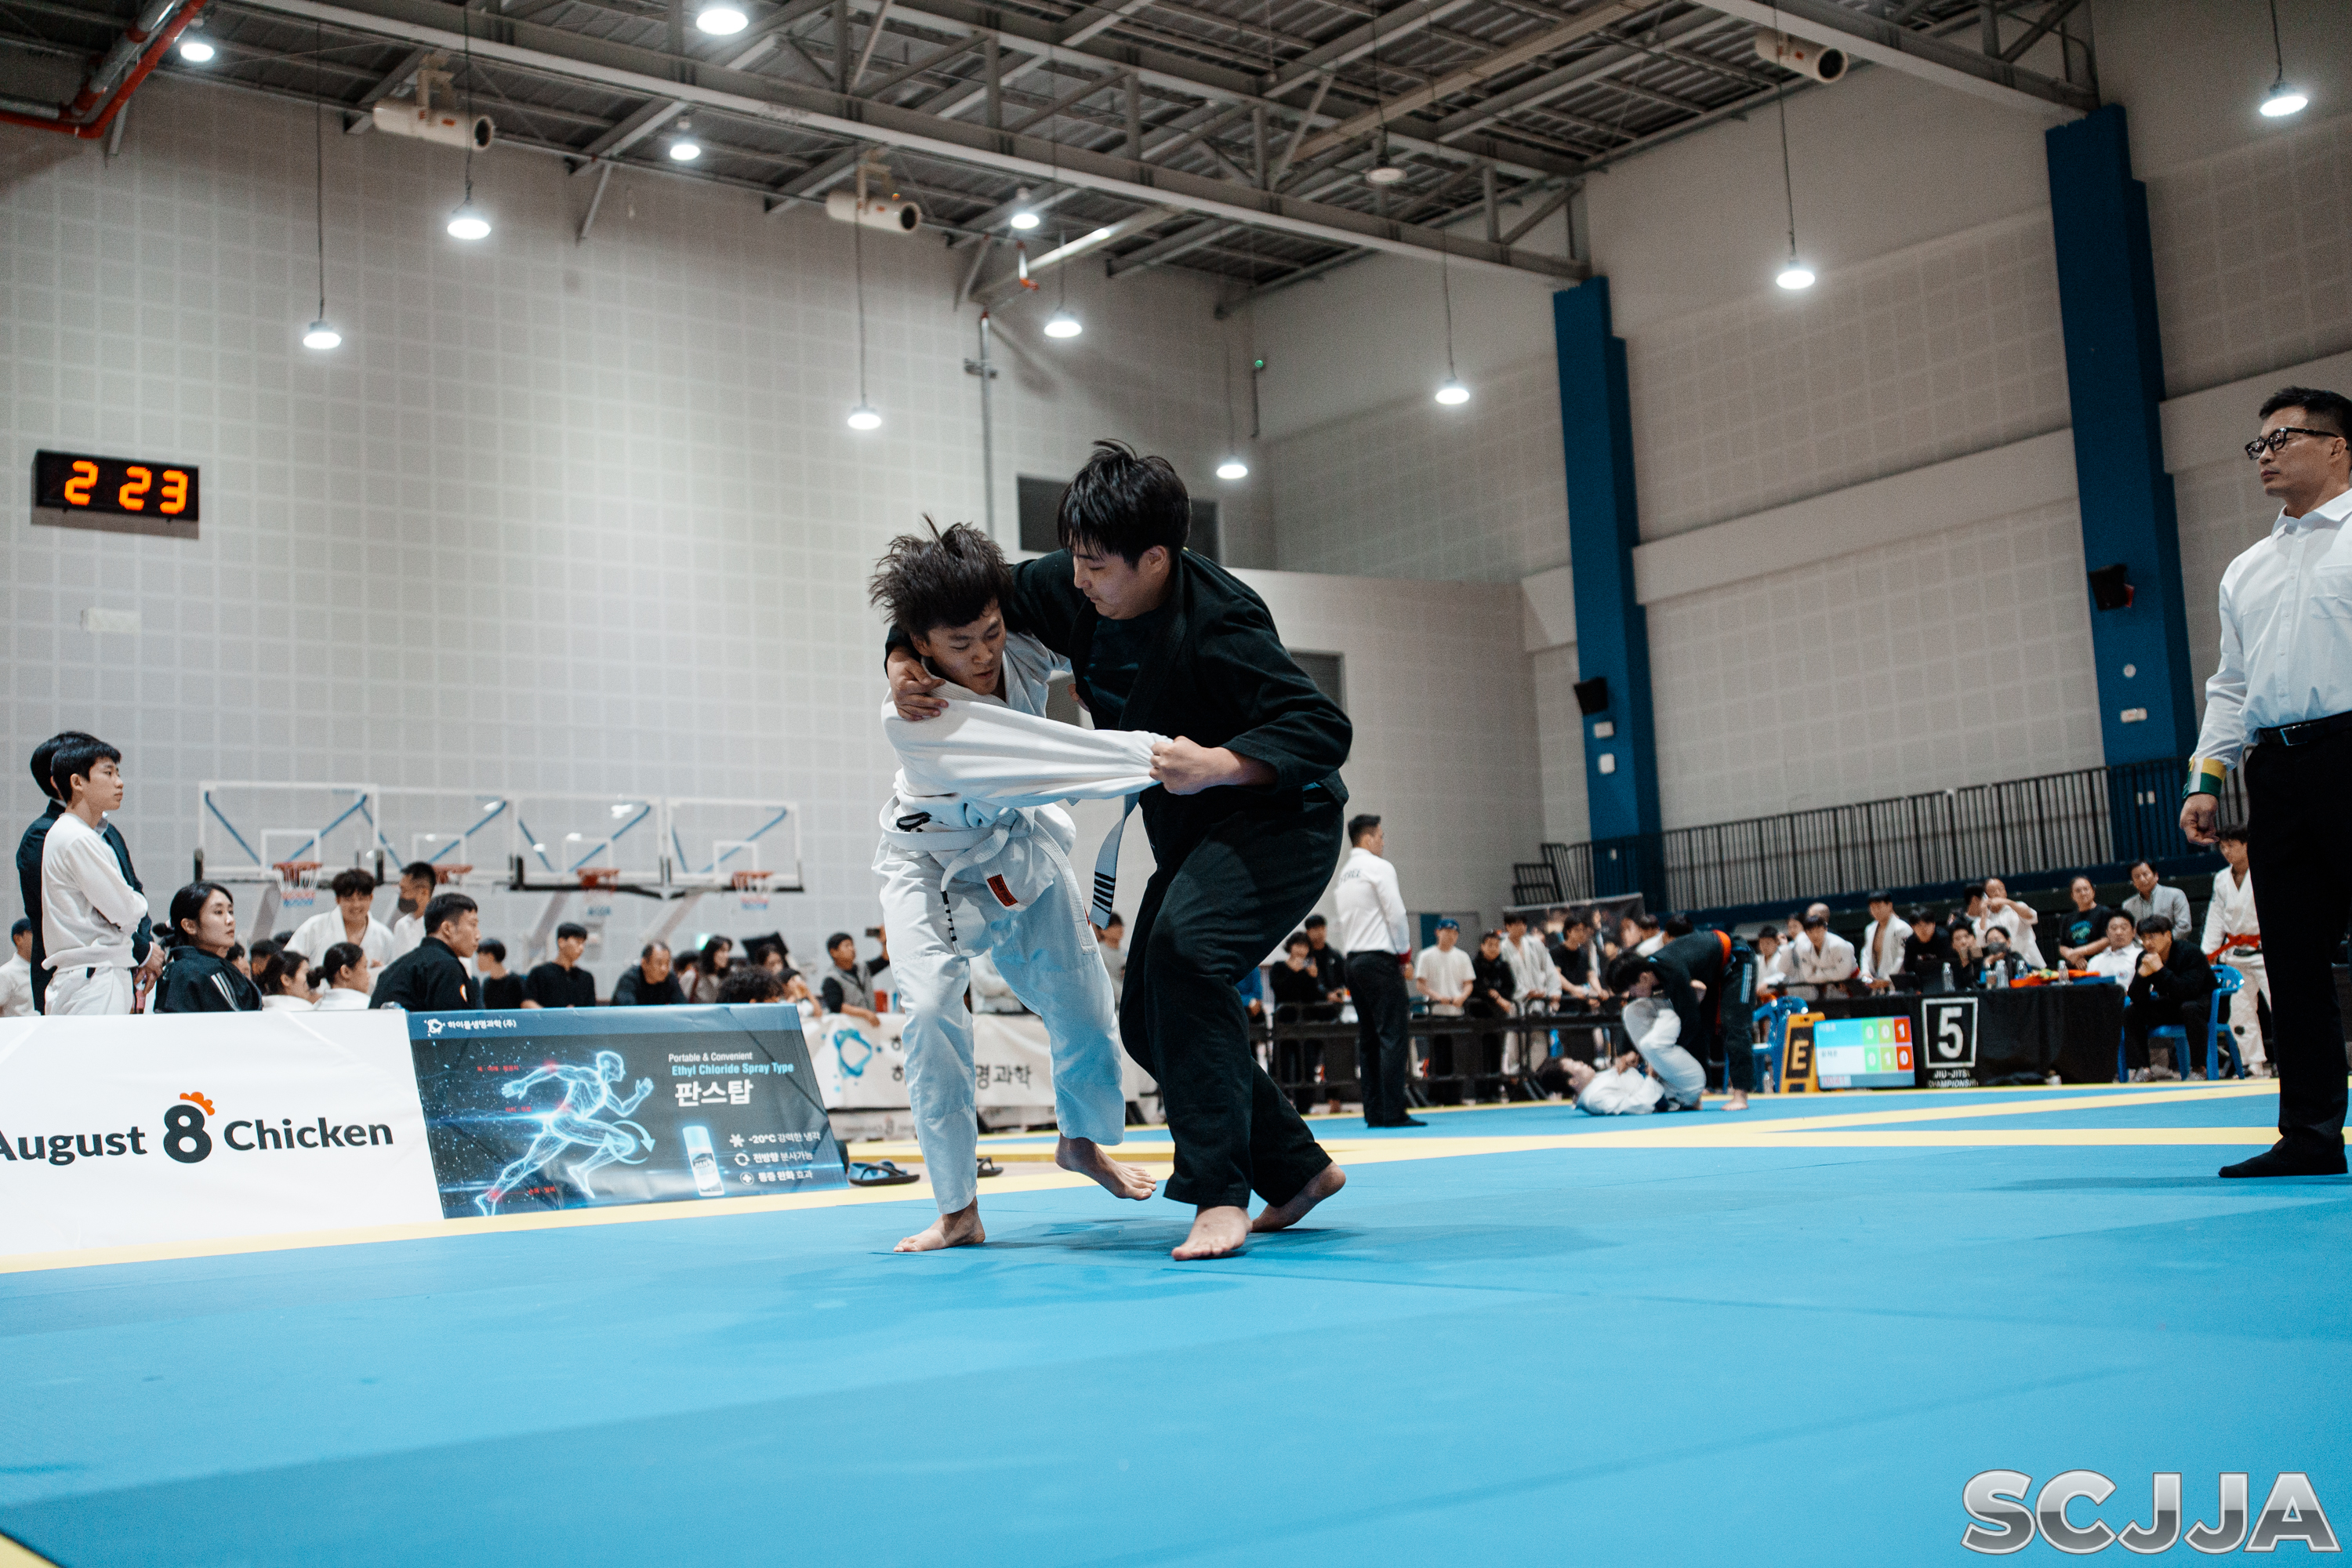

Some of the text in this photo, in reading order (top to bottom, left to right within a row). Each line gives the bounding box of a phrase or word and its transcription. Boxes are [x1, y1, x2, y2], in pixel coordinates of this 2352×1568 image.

[64, 460, 188, 514] 2 23
[1866, 1023, 1905, 1040] 0 0 1
[1937, 1007, 1963, 1058] 5
[668, 1051, 753, 1062] Portable & Convenient
[1791, 1040, 1809, 1070] E
[1867, 1051, 1908, 1066] 0 1 0
[672, 1062, 794, 1077] Ethyl Chloride Spray Type
[675, 1079, 754, 1107] 판스탑
[163, 1105, 212, 1163] 8
[224, 1117, 394, 1151] Chicken
[777, 1132, 803, 1143] 강력한
[804, 1131, 821, 1142] 냉각
[753, 1151, 813, 1163] 전방향 분사가능
[796, 1170, 813, 1178] 효과
